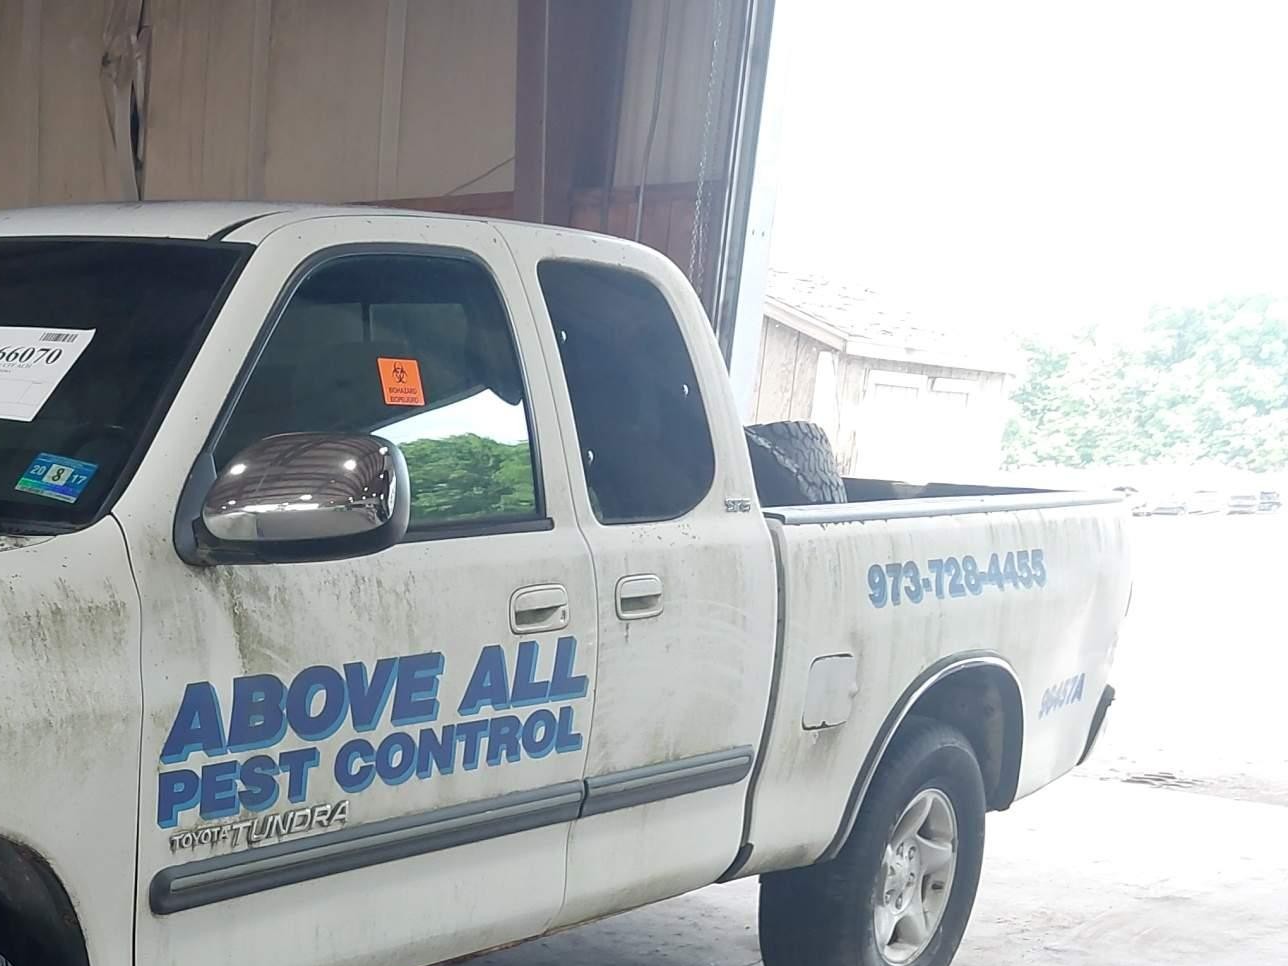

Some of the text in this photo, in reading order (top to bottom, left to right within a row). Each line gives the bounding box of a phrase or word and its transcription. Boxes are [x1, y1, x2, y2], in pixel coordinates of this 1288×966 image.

[30, 464, 88, 485] 20 8 17
[867, 549, 1048, 609] 973-728-4455
[159, 636, 589, 765] ABOVE ALL
[157, 706, 584, 829] PEST CONTROL
[170, 800, 350, 851] TOYOTA TUNDRA
